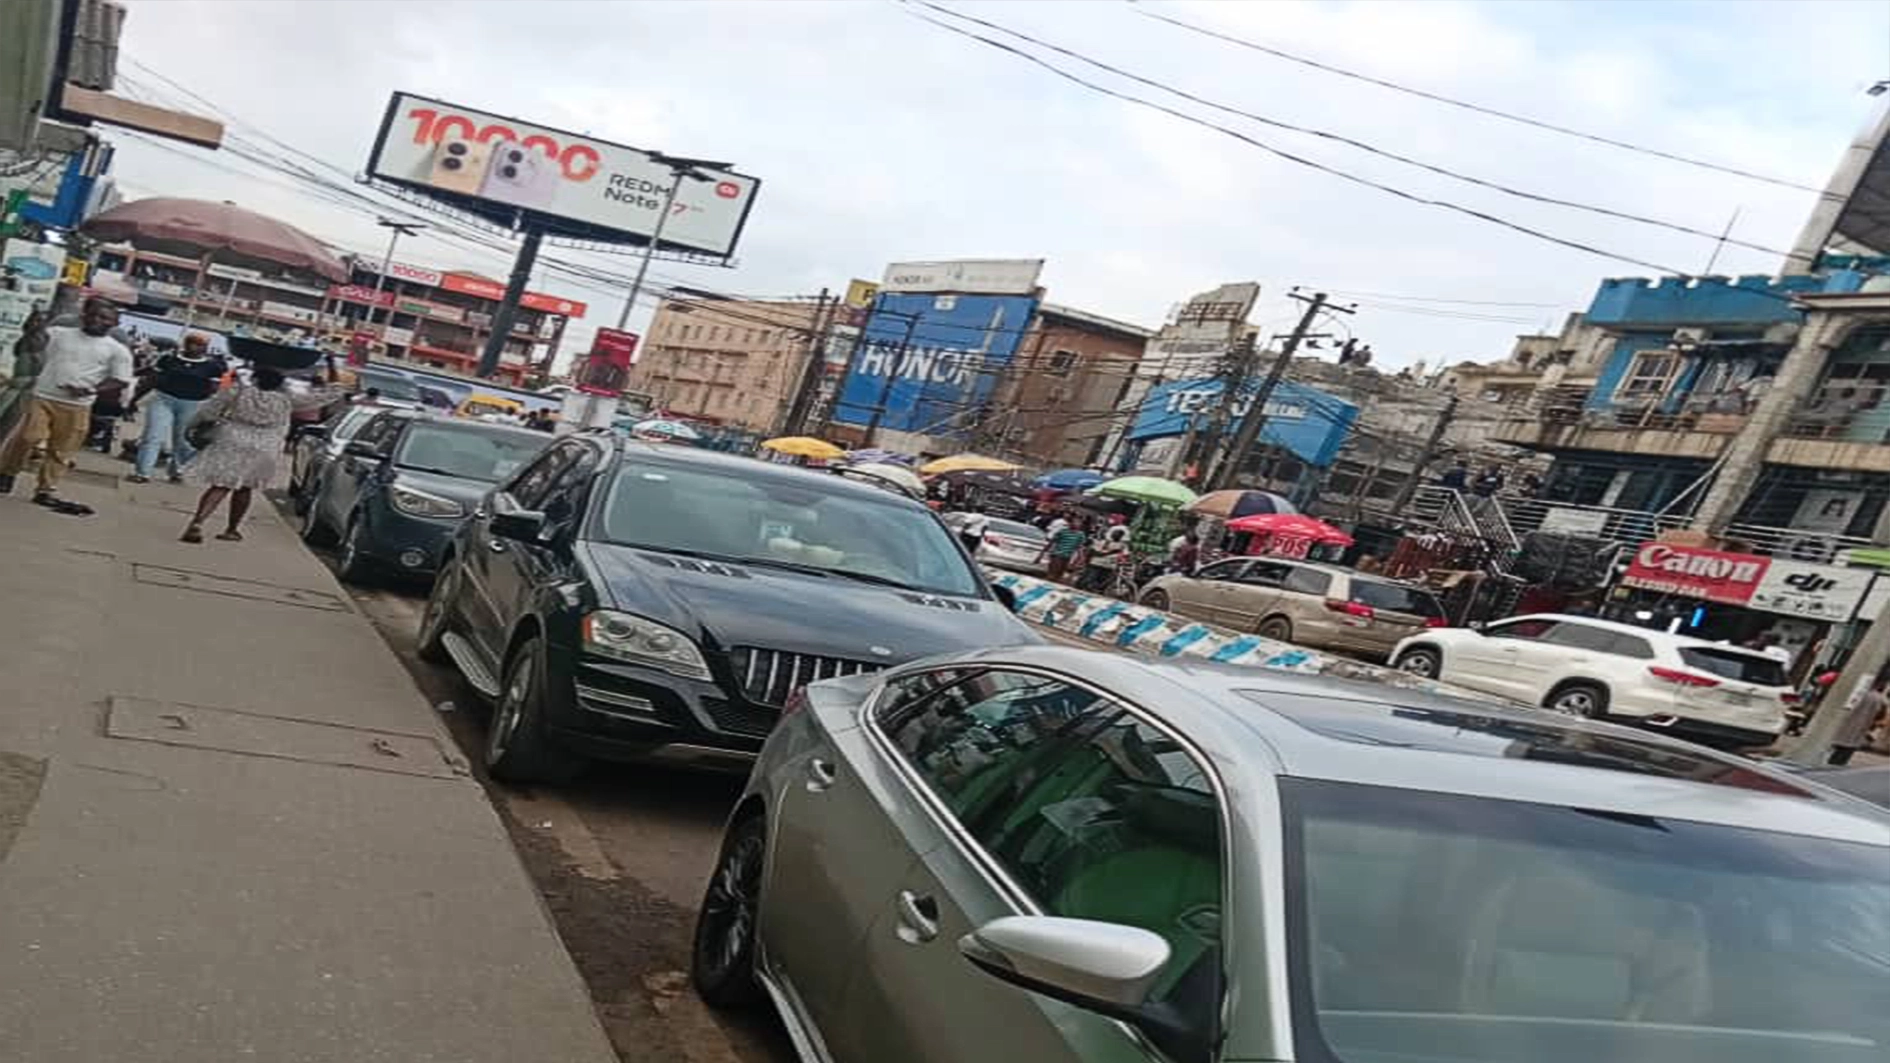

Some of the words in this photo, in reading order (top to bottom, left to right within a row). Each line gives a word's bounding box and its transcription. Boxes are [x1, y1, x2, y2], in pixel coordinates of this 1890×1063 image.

[604, 187, 660, 210] Note
[609, 174, 673, 198] REDM
[858, 344, 986, 394] HONOR
[1166, 389, 1256, 417] TECO
[1639, 545, 1760, 582] Canon
